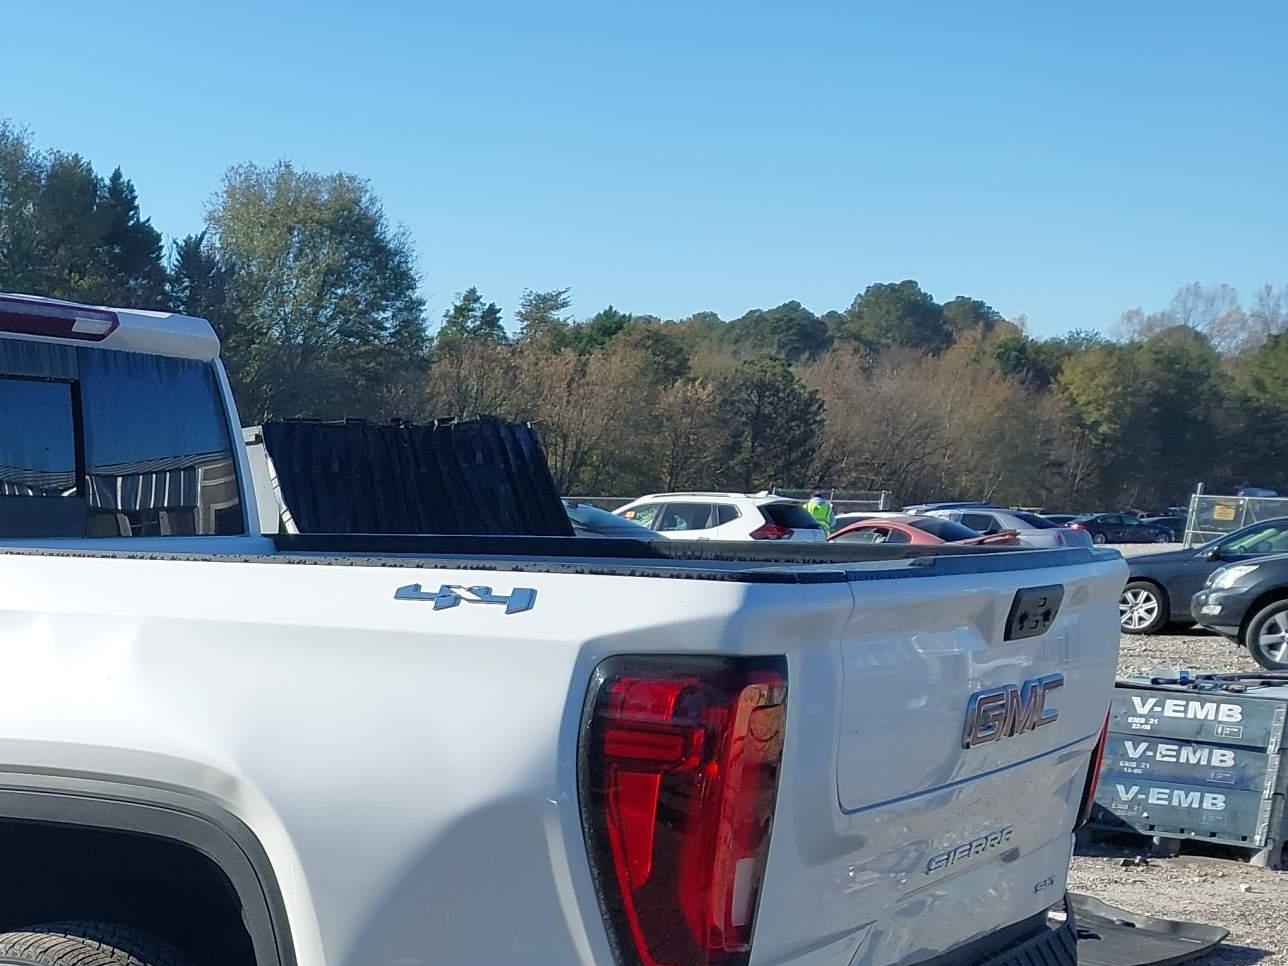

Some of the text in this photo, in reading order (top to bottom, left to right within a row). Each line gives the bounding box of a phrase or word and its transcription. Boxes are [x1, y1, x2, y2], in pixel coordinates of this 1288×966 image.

[962, 673, 1064, 749] GMC
[1131, 696, 1242, 722] V-EMB
[1124, 740, 1235, 767] V-EMB
[1115, 784, 1226, 810] V-EMB
[925, 825, 1014, 875] SIERRA
